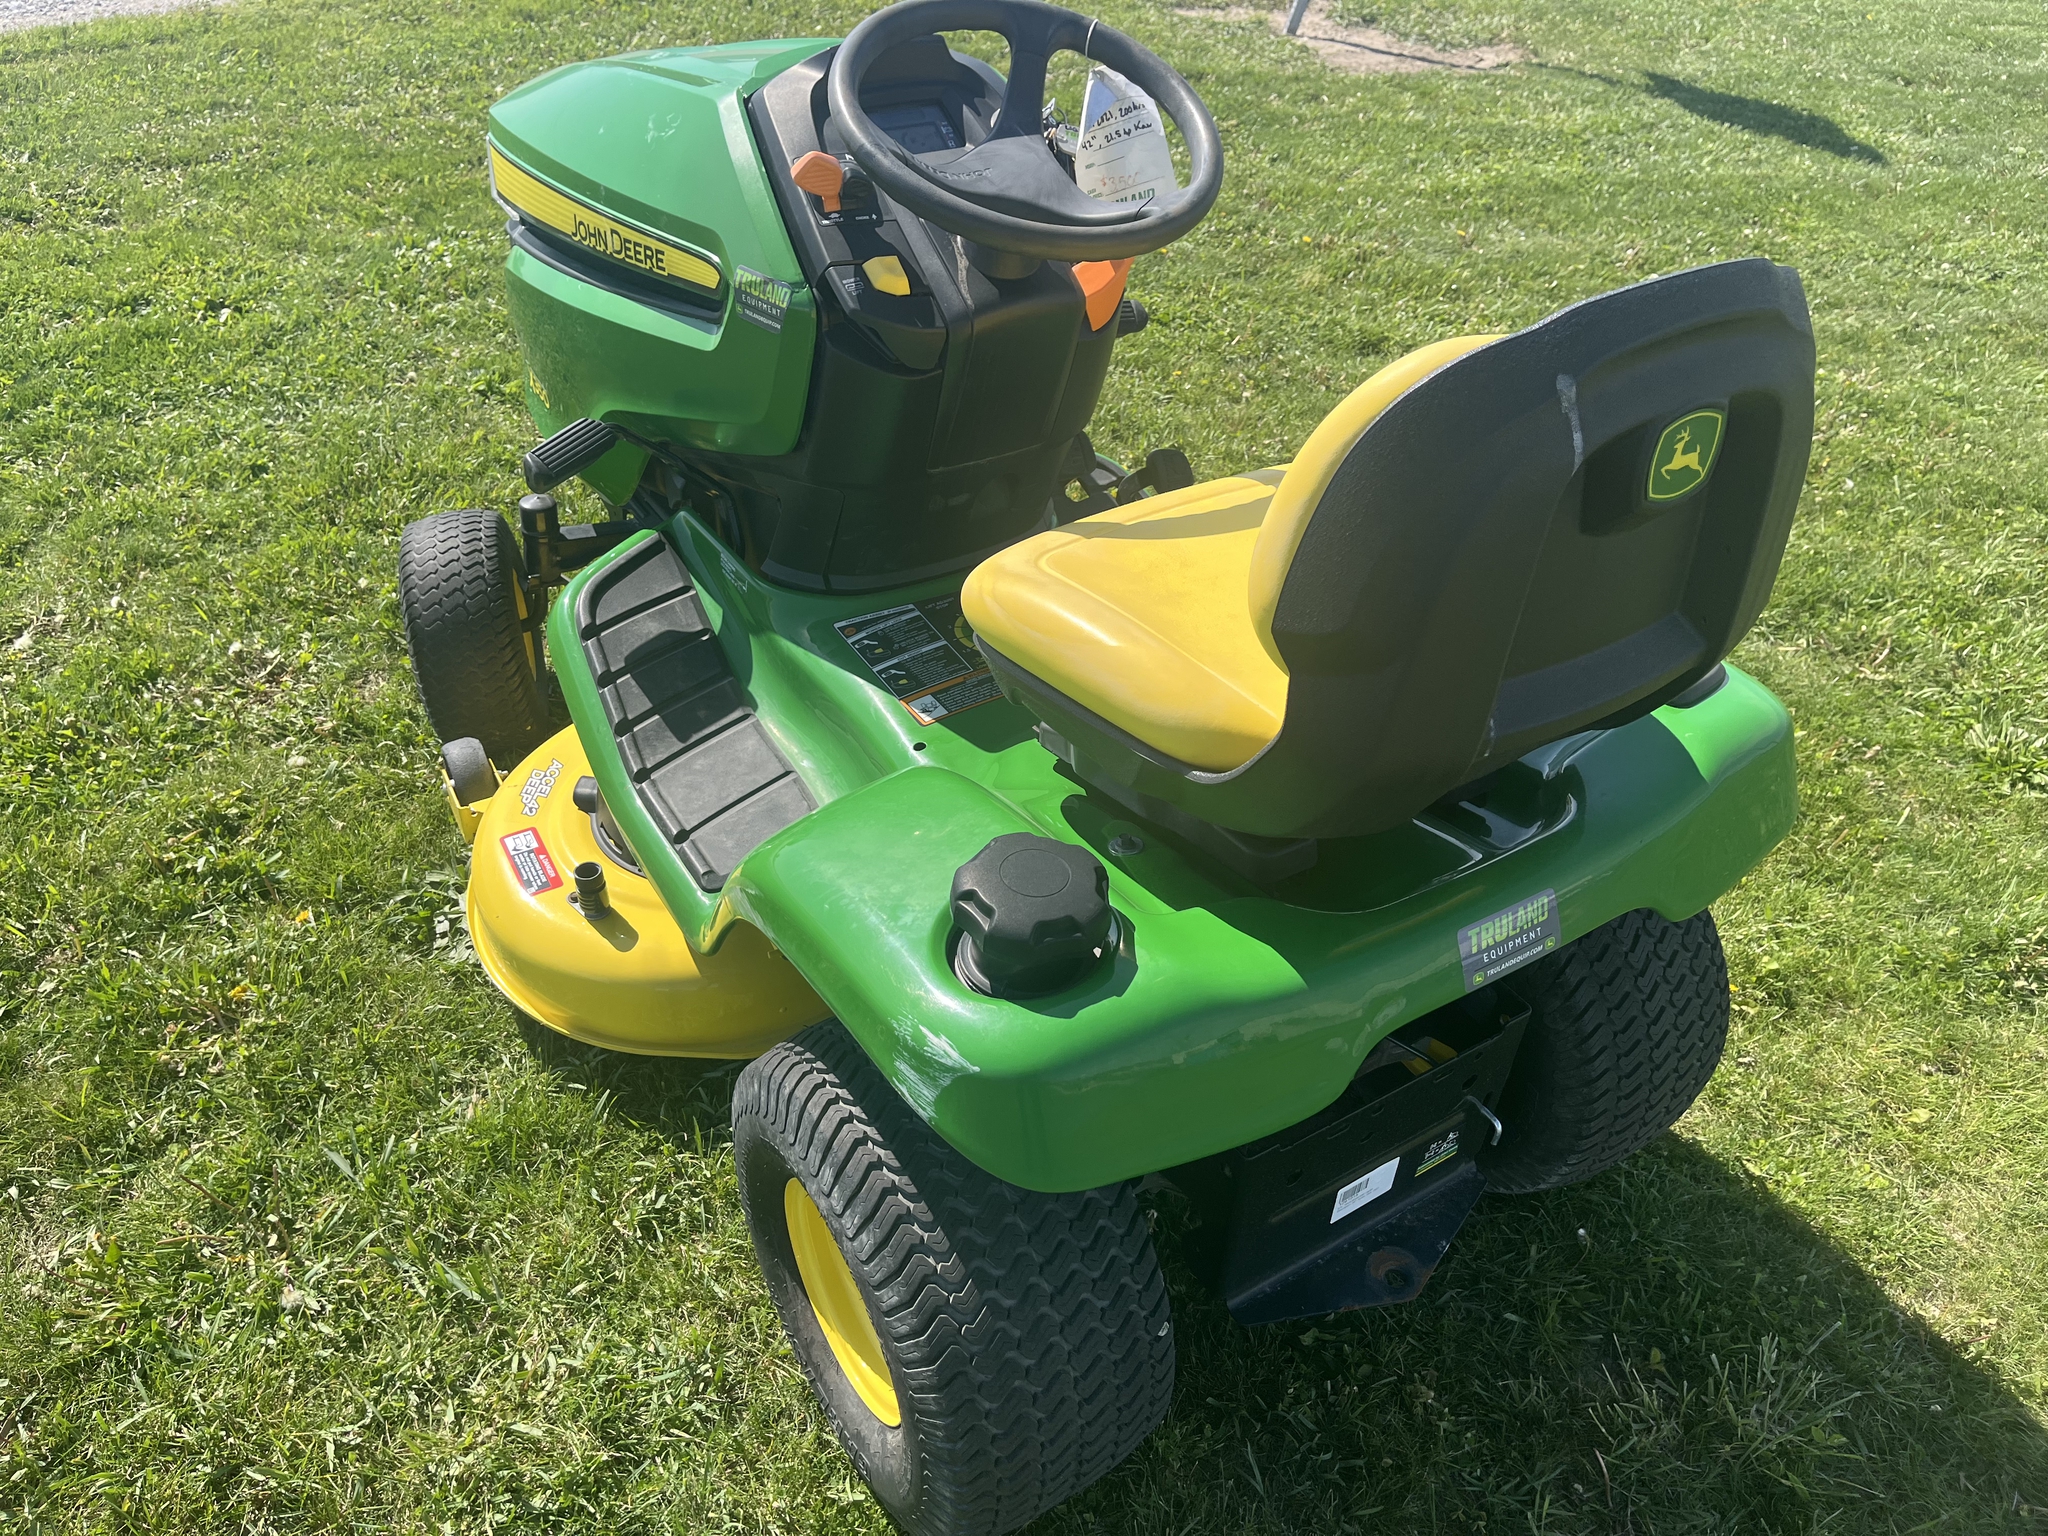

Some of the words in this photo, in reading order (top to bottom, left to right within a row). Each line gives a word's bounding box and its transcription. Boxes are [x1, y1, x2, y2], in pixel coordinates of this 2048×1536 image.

[571, 213, 609, 253] JOHN
[610, 228, 667, 273] DEERE
[735, 268, 792, 308] TRULAND
[742, 294, 781, 317] EQUIPMENT
[519, 768, 546, 805] DEEP
[1467, 895, 1549, 954] TRULAND
[1483, 927, 1542, 962] EQUIPMENT
